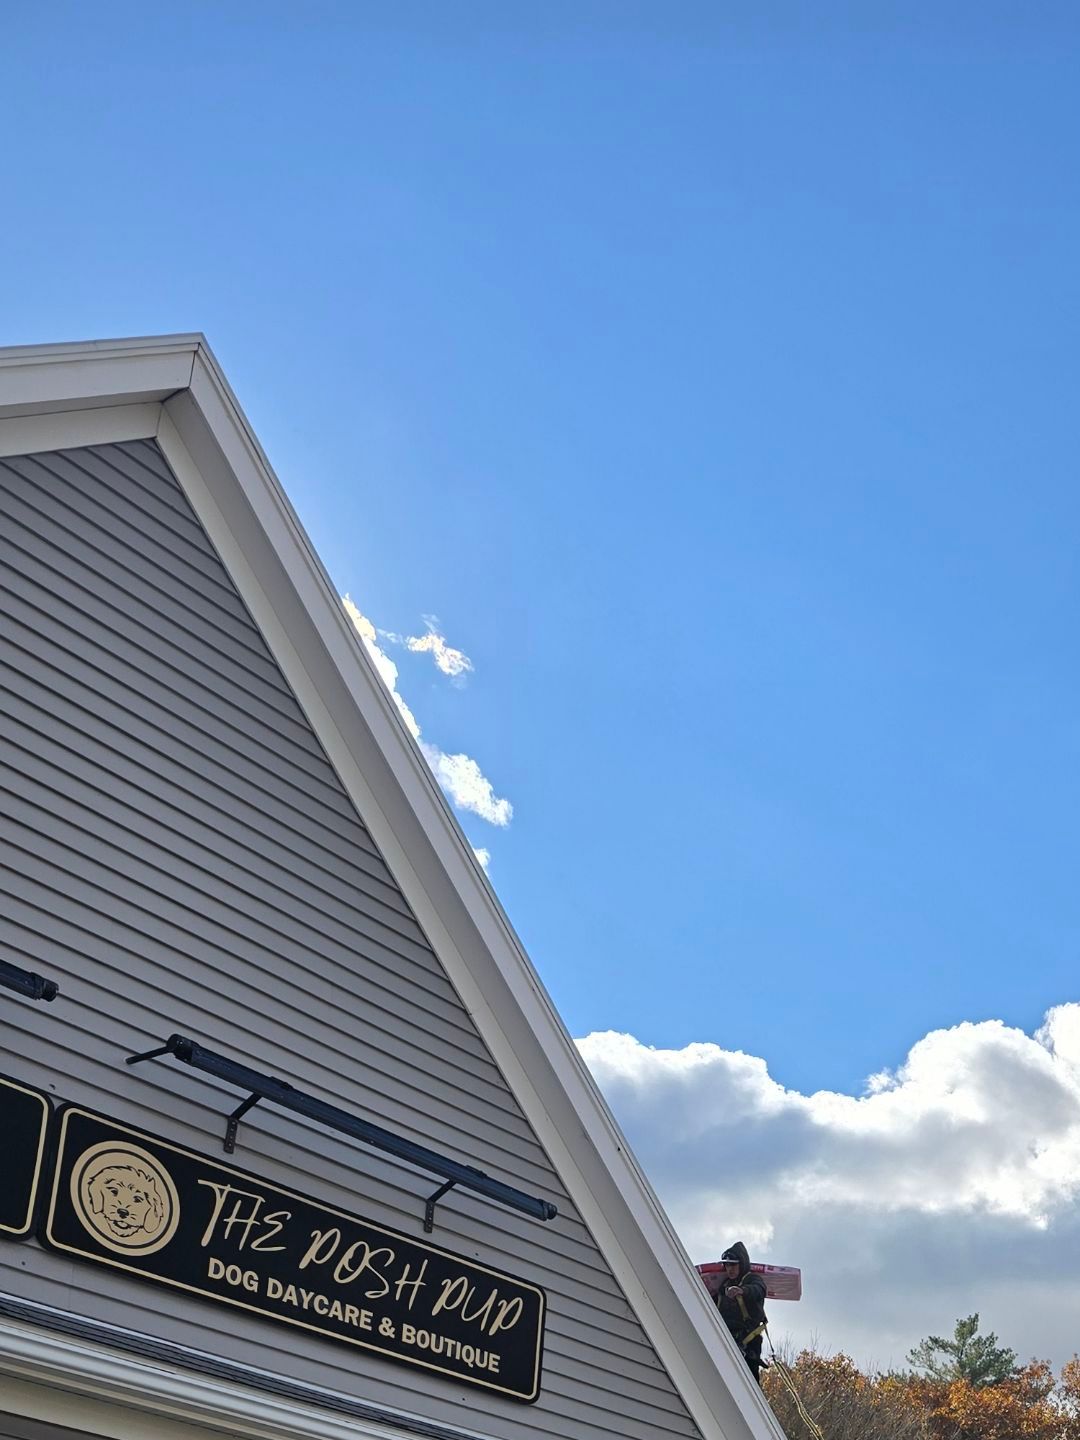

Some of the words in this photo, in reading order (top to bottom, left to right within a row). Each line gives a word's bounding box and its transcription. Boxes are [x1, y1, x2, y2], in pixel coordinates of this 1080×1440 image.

[198, 1180, 291, 1251] THE
[299, 1228, 427, 1310] POSH
[432, 1276, 524, 1336] PUP
[208, 1257, 259, 1293] DOG
[266, 1277, 374, 1331] DAYCARE
[378, 1316, 396, 1339] &
[401, 1323, 501, 1373] BOUTIQUE
